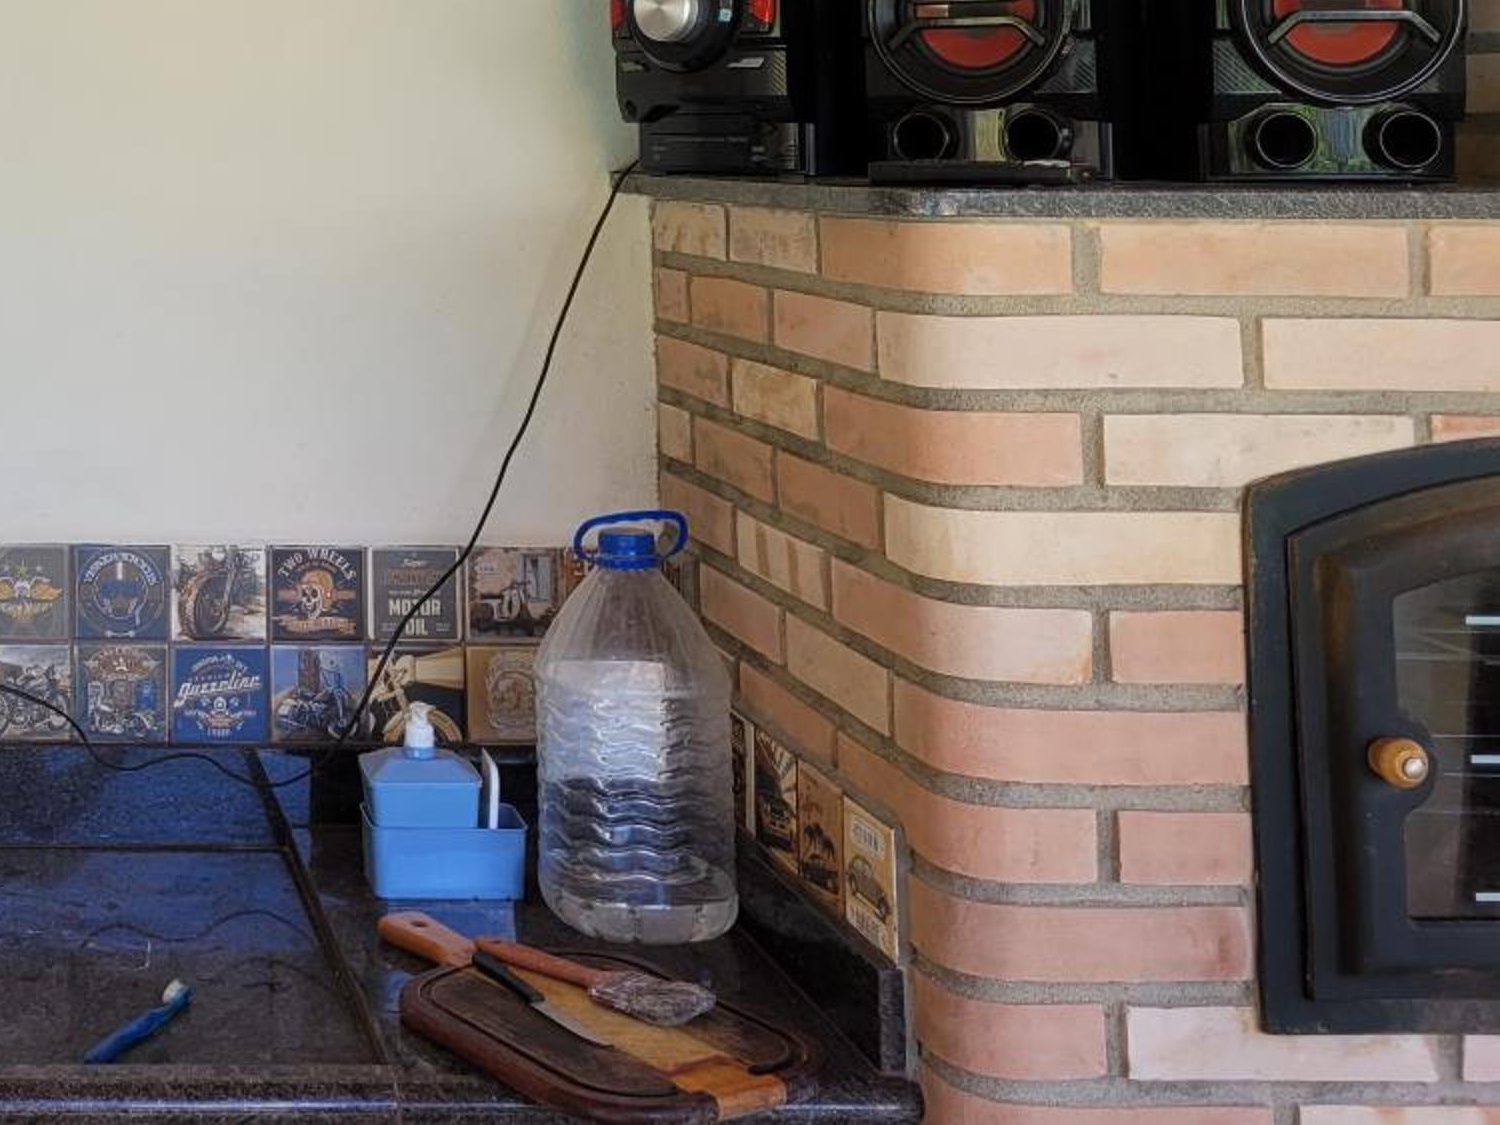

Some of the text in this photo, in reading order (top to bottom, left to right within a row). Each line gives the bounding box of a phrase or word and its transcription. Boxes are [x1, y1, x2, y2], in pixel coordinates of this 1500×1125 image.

[277, 553, 304, 577] TWO
[307, 546, 357, 580] WHEELS
[389, 598, 441, 616] MOTOR
[405, 618, 429, 636] OIL
